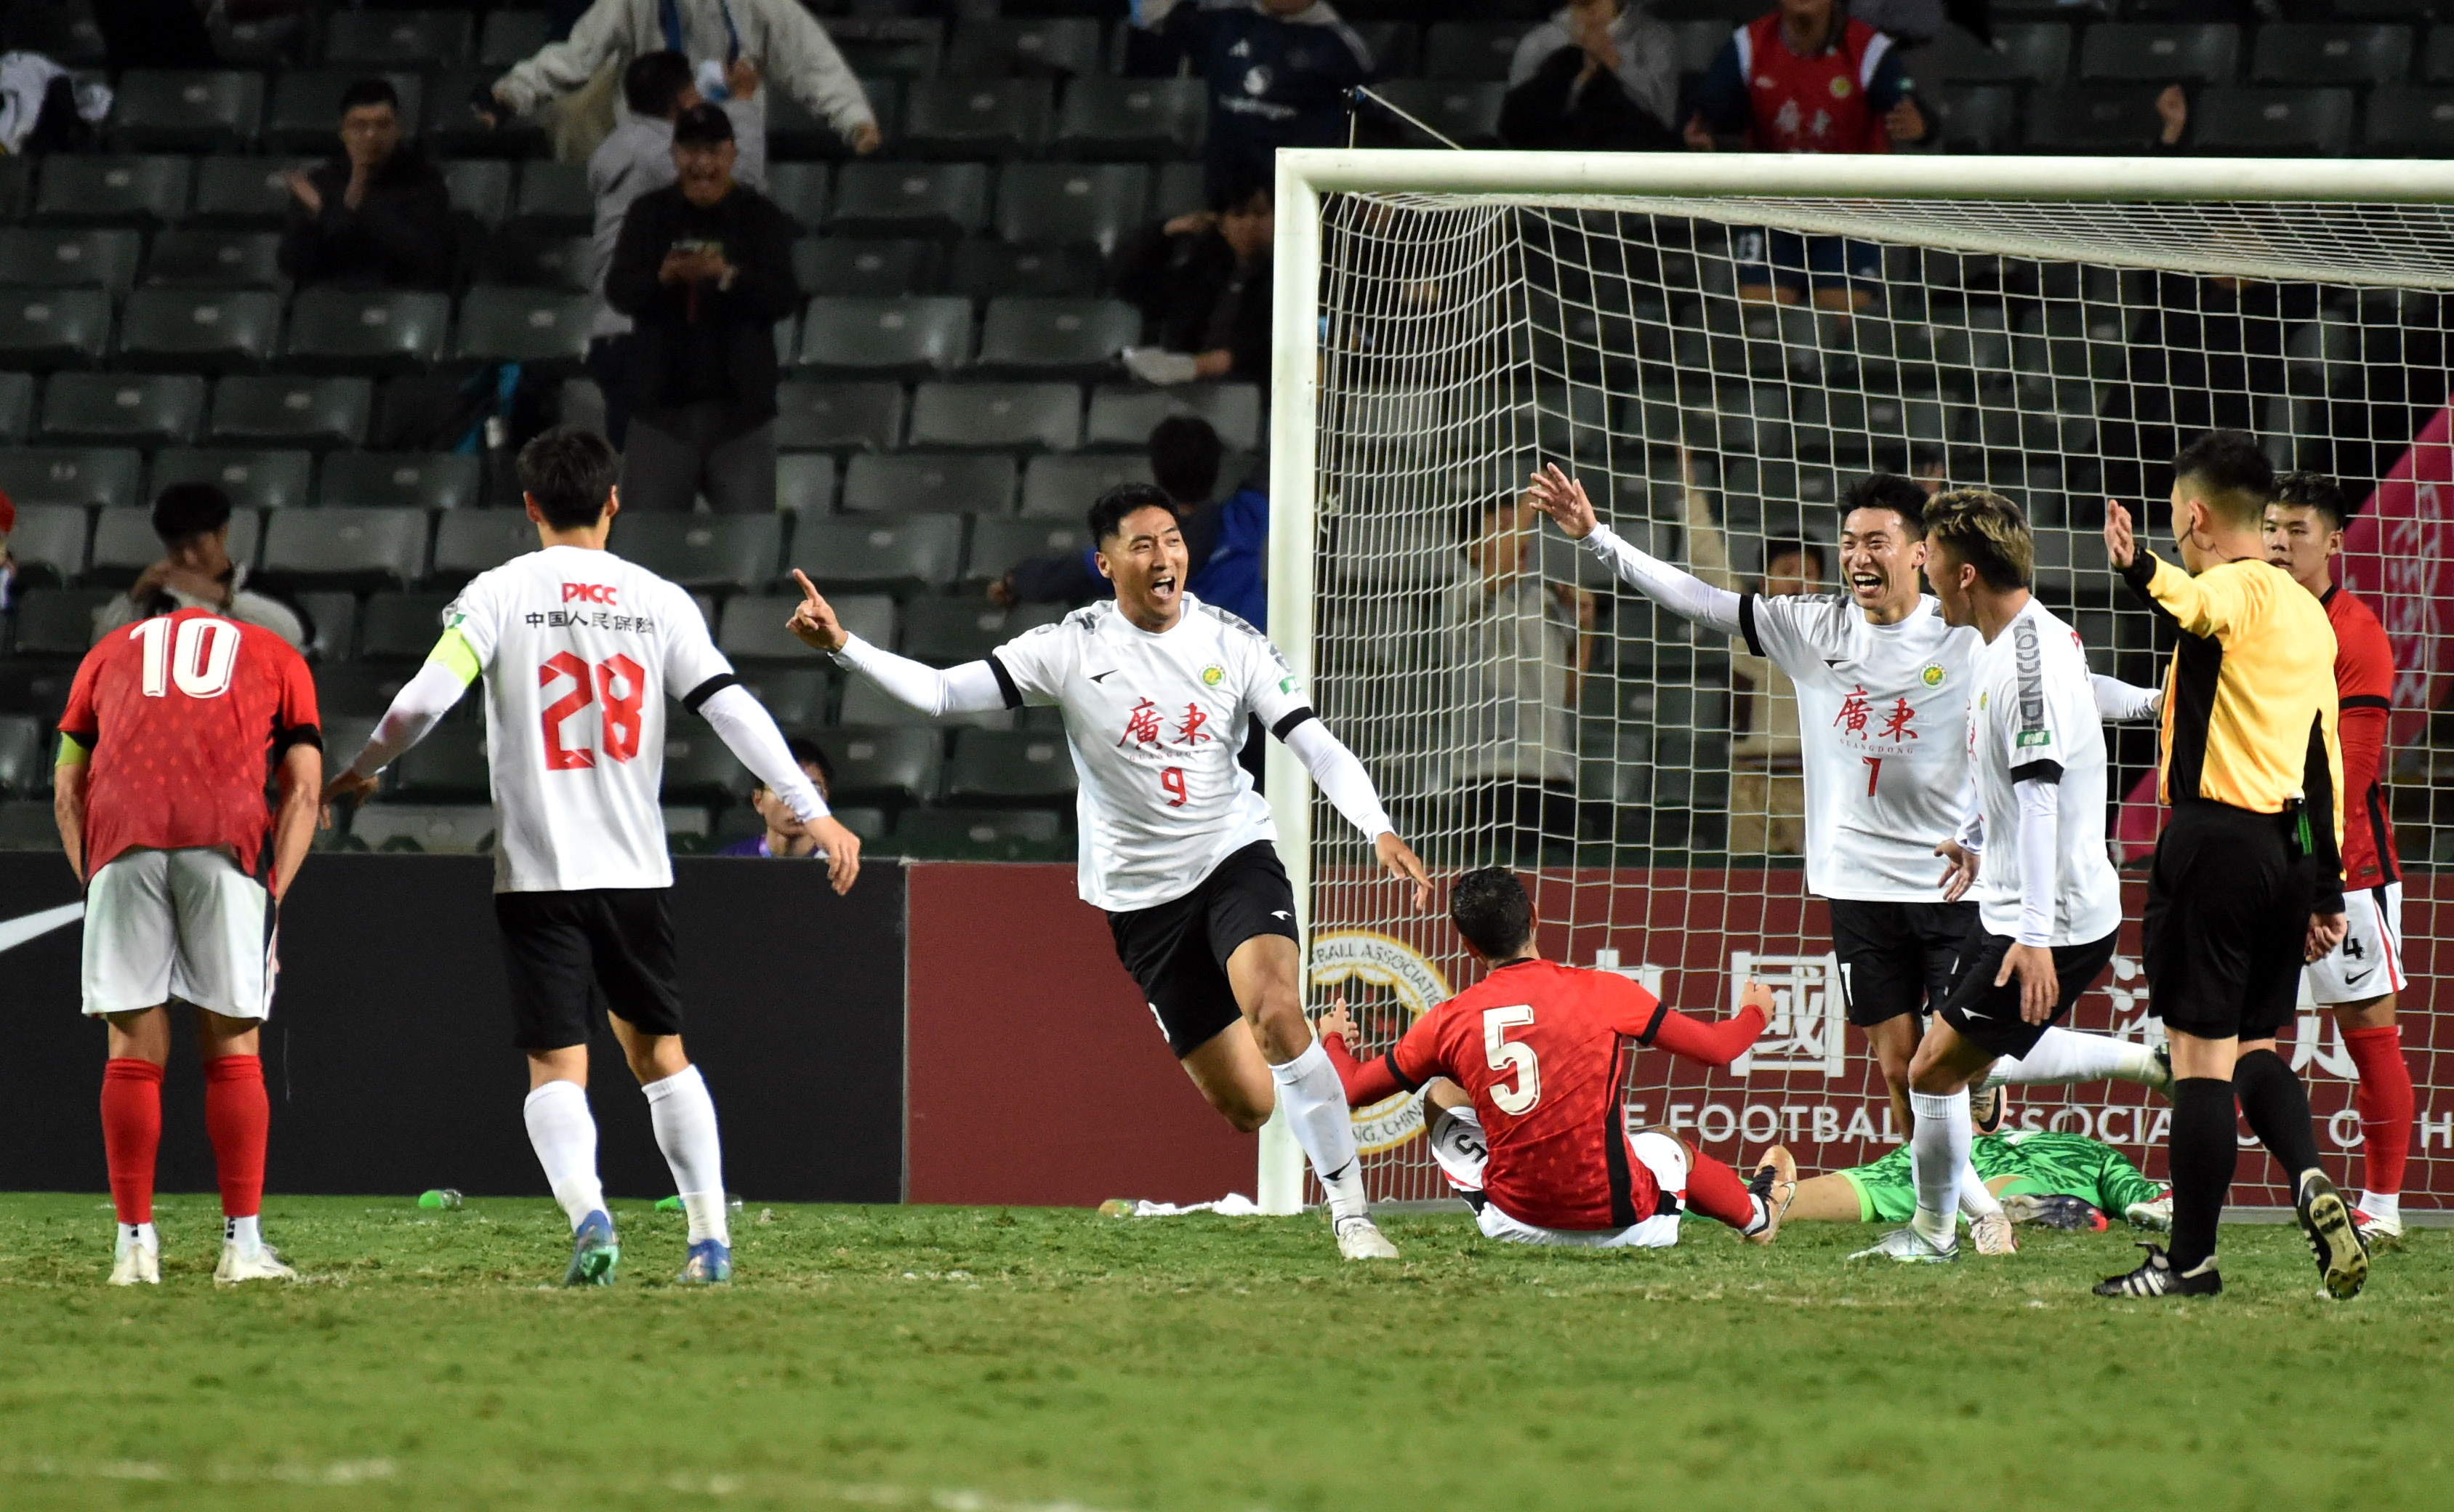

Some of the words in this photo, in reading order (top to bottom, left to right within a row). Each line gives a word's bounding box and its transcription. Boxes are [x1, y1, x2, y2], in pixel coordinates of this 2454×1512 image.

[562, 583, 616, 606] PICC
[525, 611, 655, 634] 中国人民保险
[129, 617, 241, 699] 10
[539, 650, 645, 771] 28
[1117, 696, 1210, 750] 廣東
[1833, 684, 1918, 743] 廣東
[1840, 739, 1914, 755] GUANGDONG
[1161, 766, 1187, 807] 9
[2343, 921, 2365, 960] 4
[1360, 943, 1444, 1009] ASSOCIATIO
[1483, 1005, 1540, 1116] 5
[1670, 1103, 1904, 1144] FOOTBAL
[1455, 1134, 1488, 1165] 5
